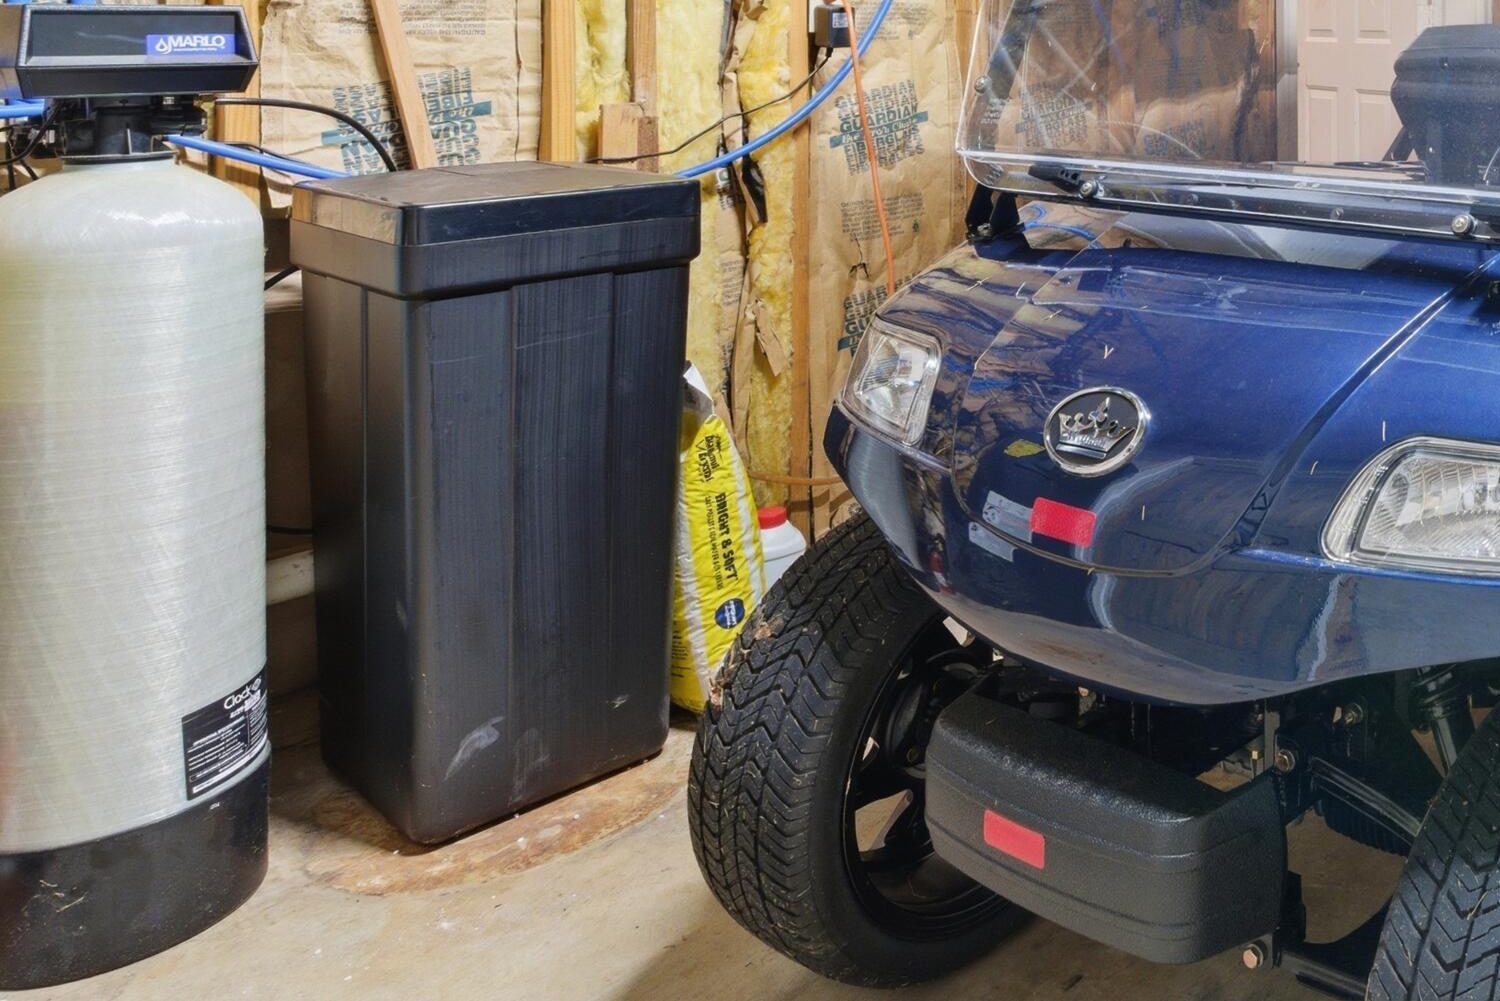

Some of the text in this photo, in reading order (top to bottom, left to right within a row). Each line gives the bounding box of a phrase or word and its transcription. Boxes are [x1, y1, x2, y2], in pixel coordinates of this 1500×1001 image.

[168, 34, 226, 48] MARLO
[844, 126, 920, 152] FIBRGLASS
[714, 492, 738, 580] BRIGHT & SOFT
